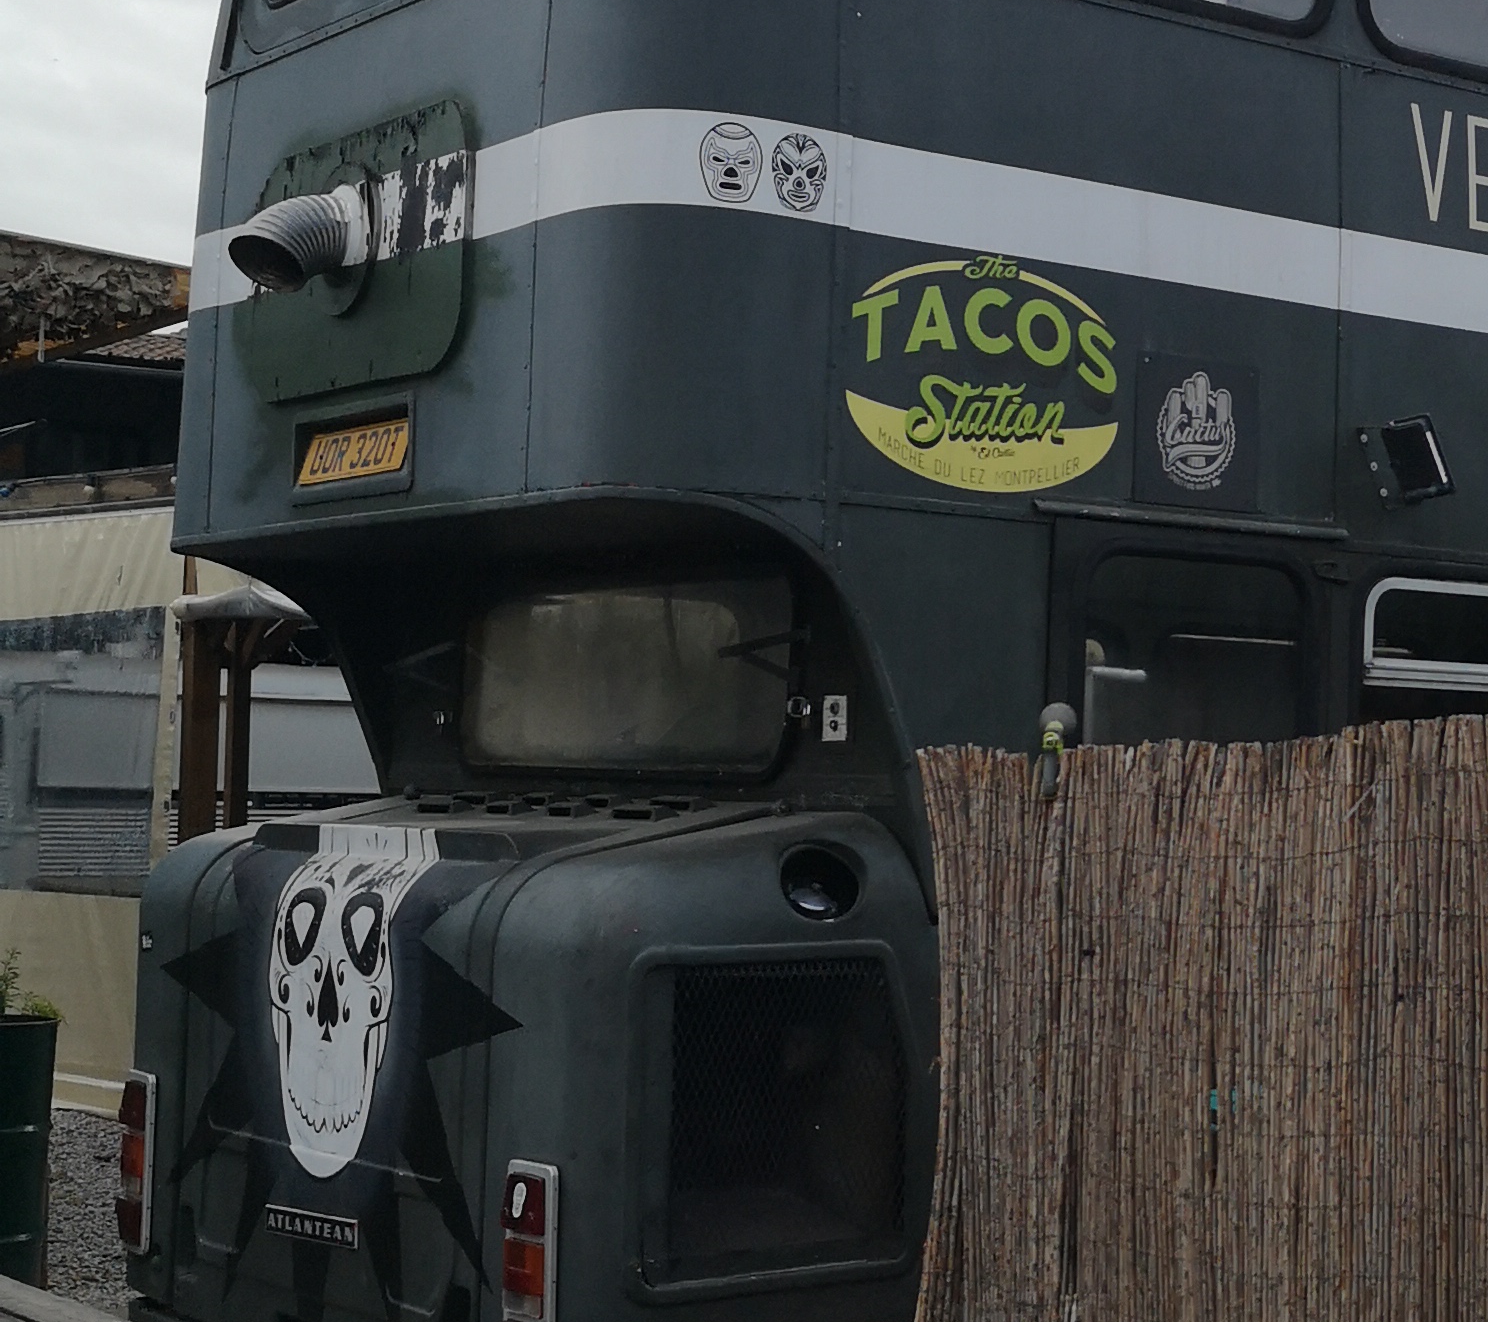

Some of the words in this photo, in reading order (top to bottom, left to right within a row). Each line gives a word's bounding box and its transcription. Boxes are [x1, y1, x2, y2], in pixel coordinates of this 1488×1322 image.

[964, 255, 1018, 280] The
[852, 285, 1118, 394] TACOS
[904, 374, 1065, 446] Station
[349, 425, 404, 470] 320T
[878, 427, 925, 470] MARCHE
[934, 458, 951, 477] DU
[960, 466, 986, 485] LEZ
[996, 457, 1080, 486] MONTPELLIER
[267, 1212, 354, 1243] ATLANTEAN
